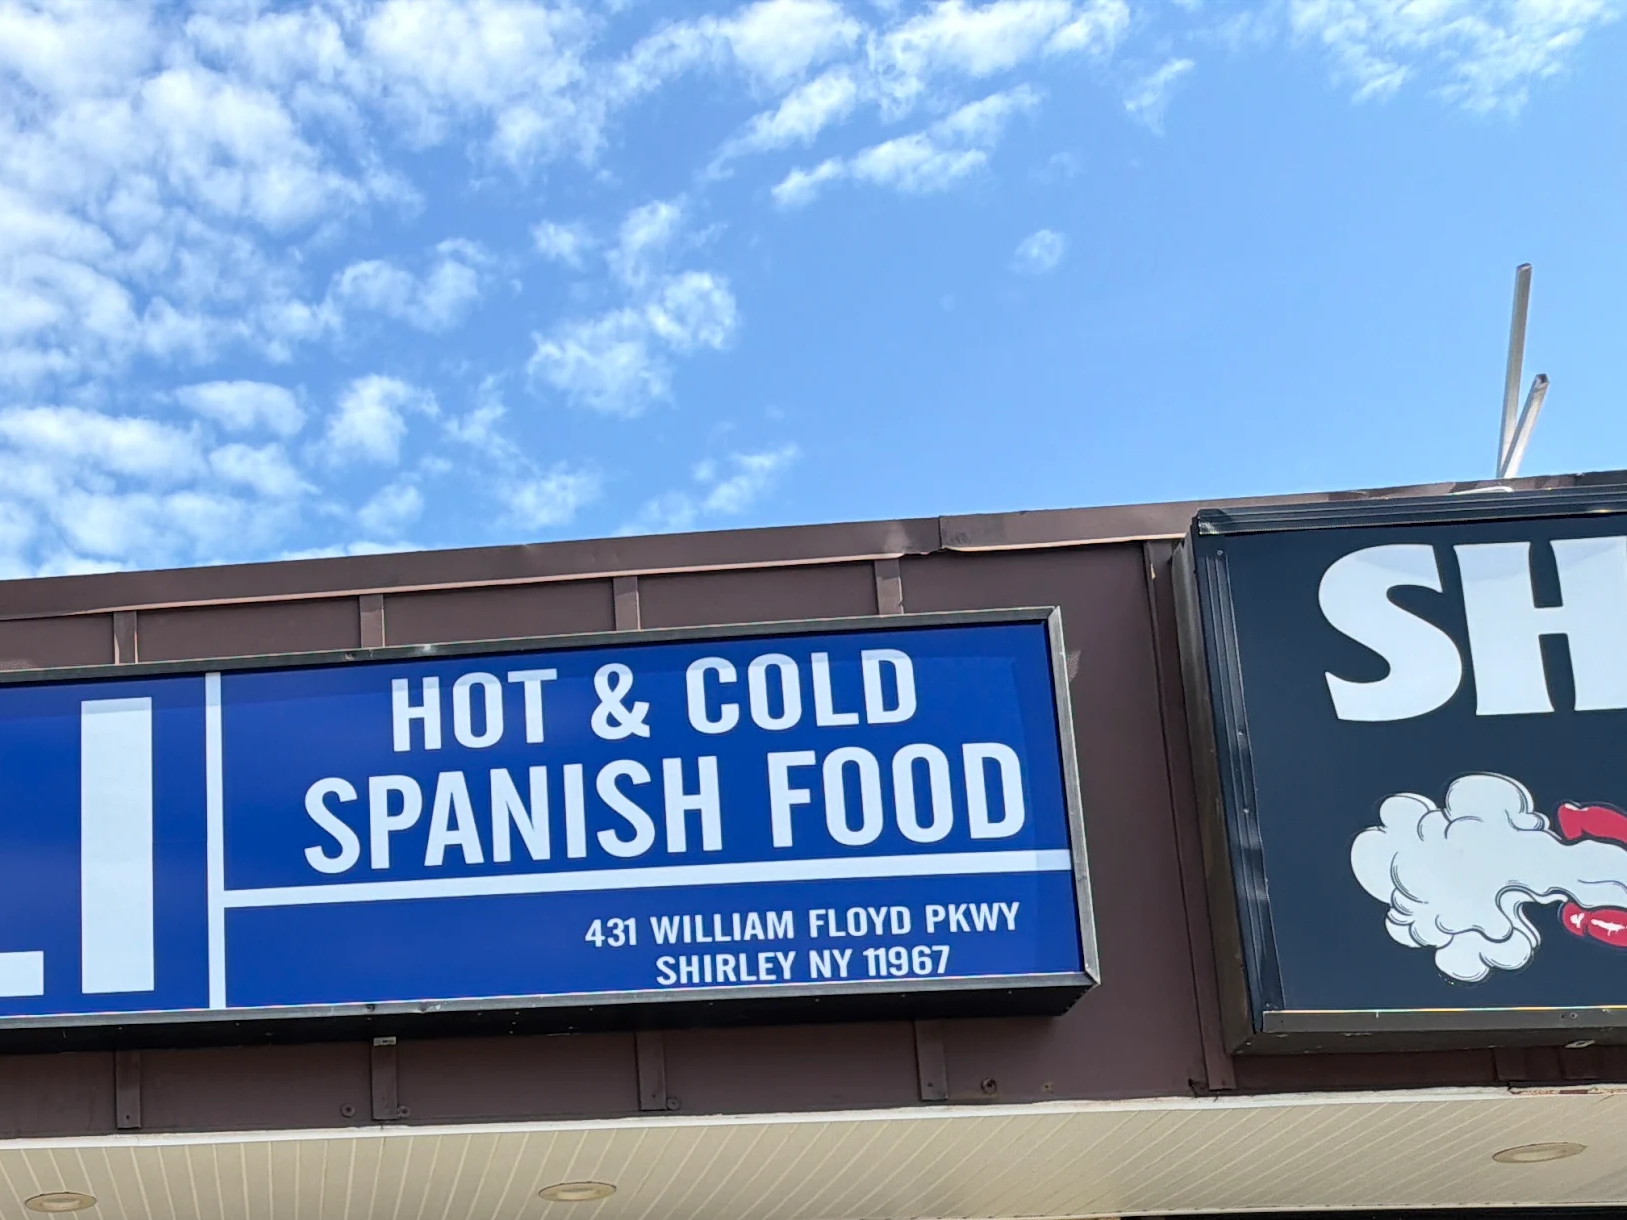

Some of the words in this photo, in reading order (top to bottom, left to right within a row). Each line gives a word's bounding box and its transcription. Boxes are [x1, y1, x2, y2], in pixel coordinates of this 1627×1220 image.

[1319, 536, 1627, 721] SH
[391, 668, 558, 752] HOT
[590, 662, 652, 740] &
[686, 648, 918, 735] COLD
[303, 754, 722, 875] SPANISH
[768, 742, 1026, 848] FOOD
[584, 917, 638, 949] 431
[649, 910, 795, 946] WILLIAM
[809, 905, 911, 938] FLOYD
[926, 901, 1020, 934] PKWY
[656, 950, 797, 986] SHIRLEY
[809, 948, 853, 980] NY
[861, 943, 950, 977] 11967
